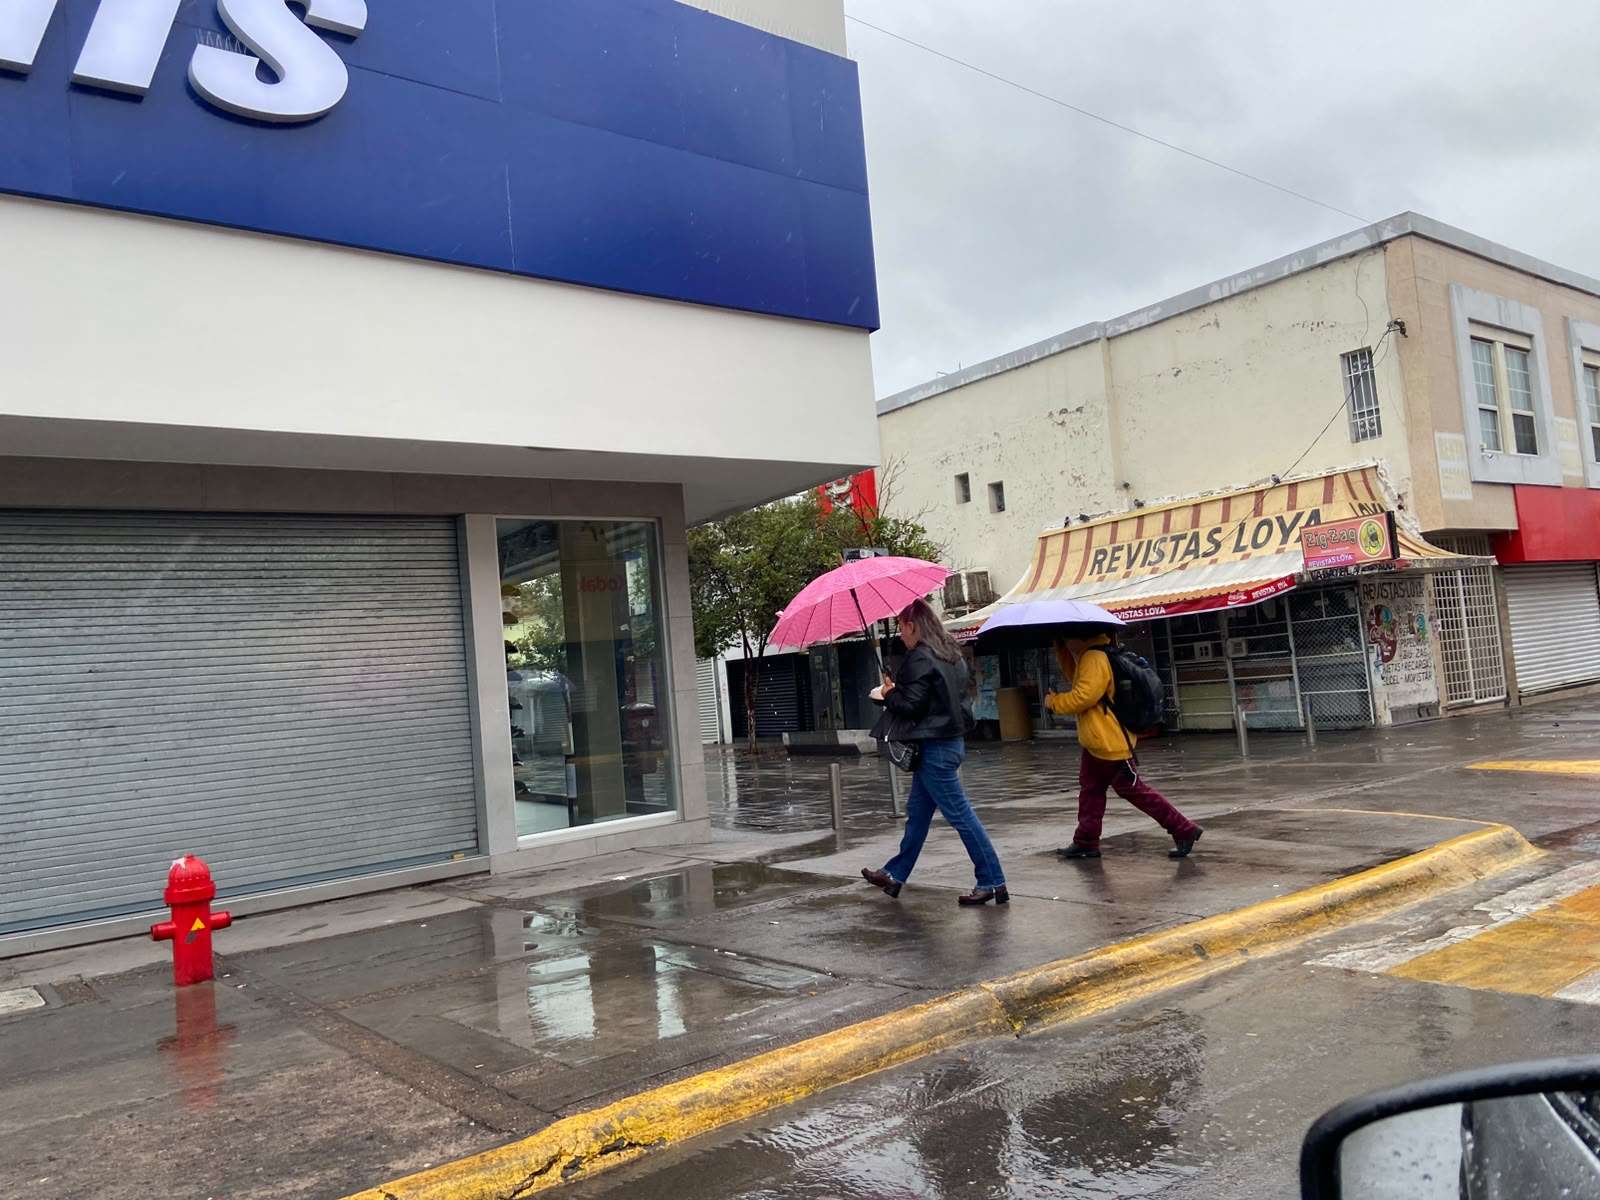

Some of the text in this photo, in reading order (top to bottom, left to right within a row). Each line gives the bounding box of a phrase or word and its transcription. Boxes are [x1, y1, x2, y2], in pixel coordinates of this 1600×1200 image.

[1088, 509, 1321, 575] REVISTAS LOYA
[1308, 553, 1353, 568] REVISTAS LOYA
[1252, 585, 1276, 599] REVISTAS
[1113, 607, 1166, 620] EVISTAS LOYA
